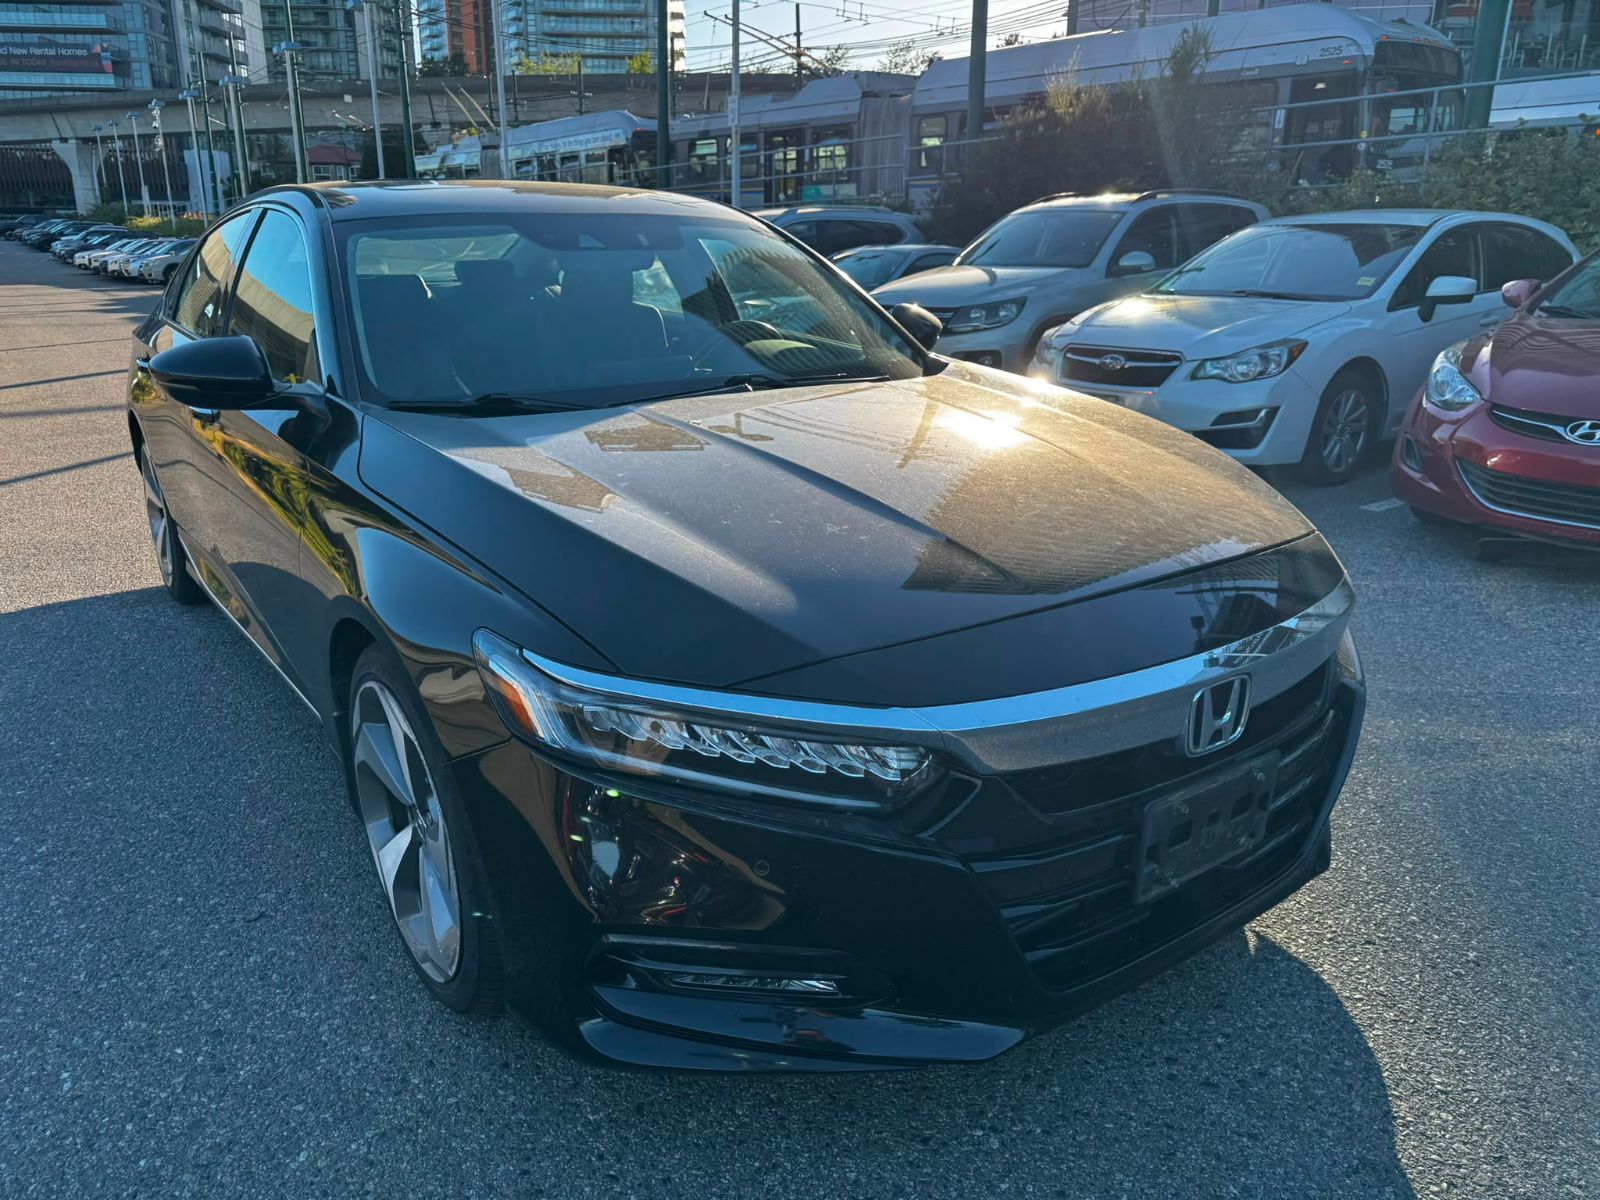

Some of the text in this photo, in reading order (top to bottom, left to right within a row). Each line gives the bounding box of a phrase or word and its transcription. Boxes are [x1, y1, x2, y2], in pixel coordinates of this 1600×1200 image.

[9, 46, 28, 55] New
[30, 46, 56, 55] Rental
[58, 47, 88, 56] Homes
[1320, 46, 1343, 57] 2525
